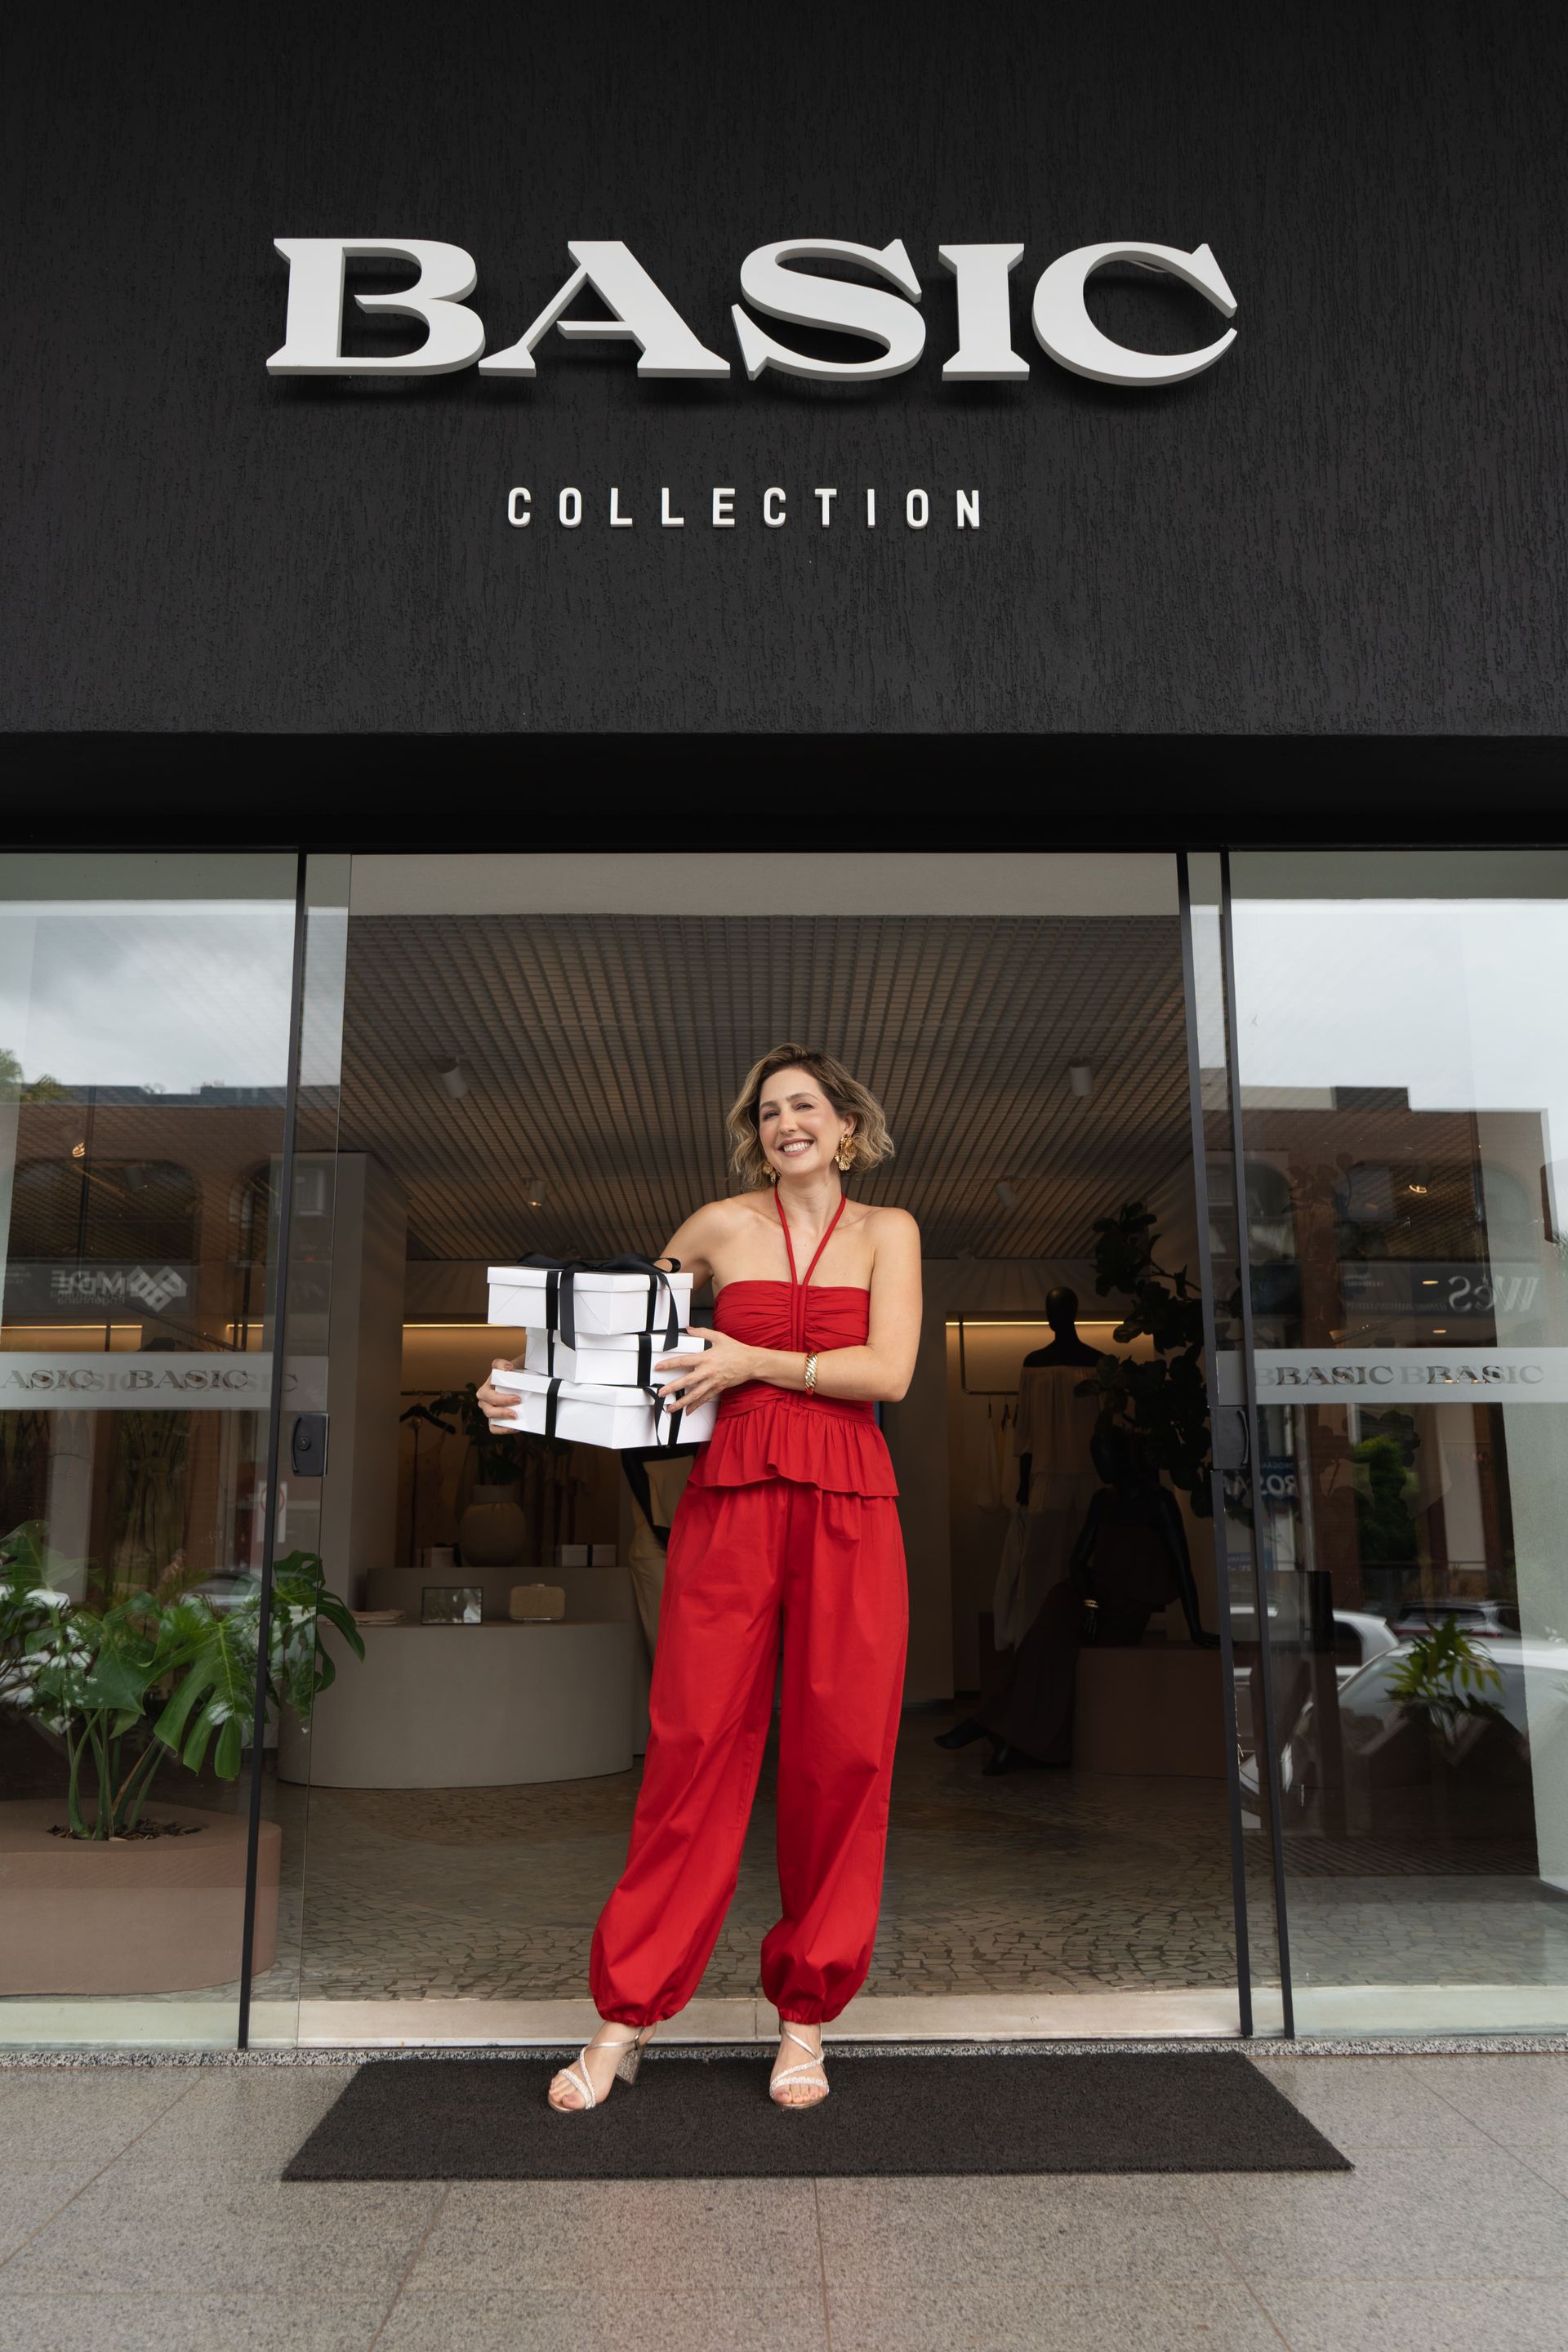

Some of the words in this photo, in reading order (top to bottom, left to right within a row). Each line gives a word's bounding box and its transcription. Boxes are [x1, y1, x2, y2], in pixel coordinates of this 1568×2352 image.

[266, 237, 1239, 388] BASIC
[507, 486, 981, 531] COLLECTION
[127, 1369, 248, 1390] BASIC
[1276, 1365, 1395, 1386] BASIC
[1426, 1365, 1544, 1386] BASIC
